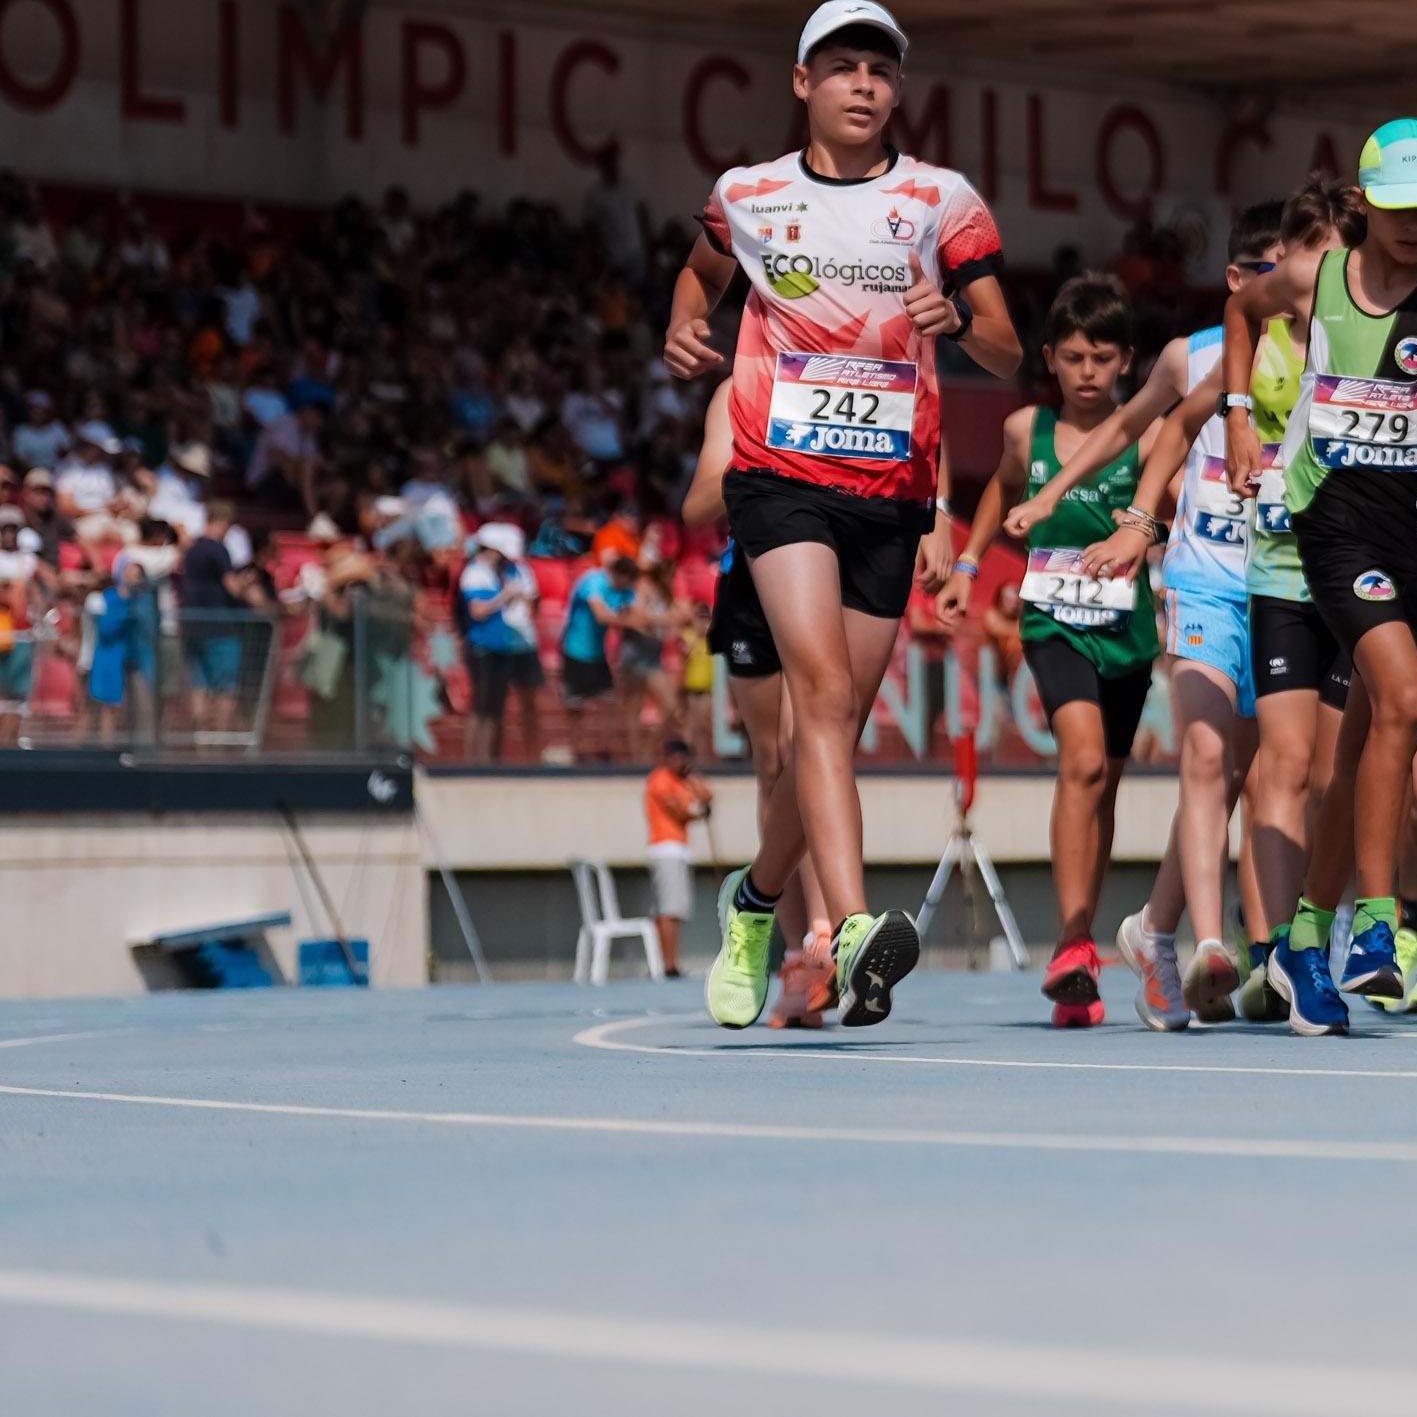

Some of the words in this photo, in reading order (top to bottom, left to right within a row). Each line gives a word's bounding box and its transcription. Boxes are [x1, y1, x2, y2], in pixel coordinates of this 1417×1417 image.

[682, 54, 1167, 224] CMILO
[751, 202, 793, 214] luanvi
[809, 389, 880, 425] 242
[809, 424, 894, 453] Joma
[1337, 410, 1410, 443] 279
[1047, 576, 1104, 606] 212
